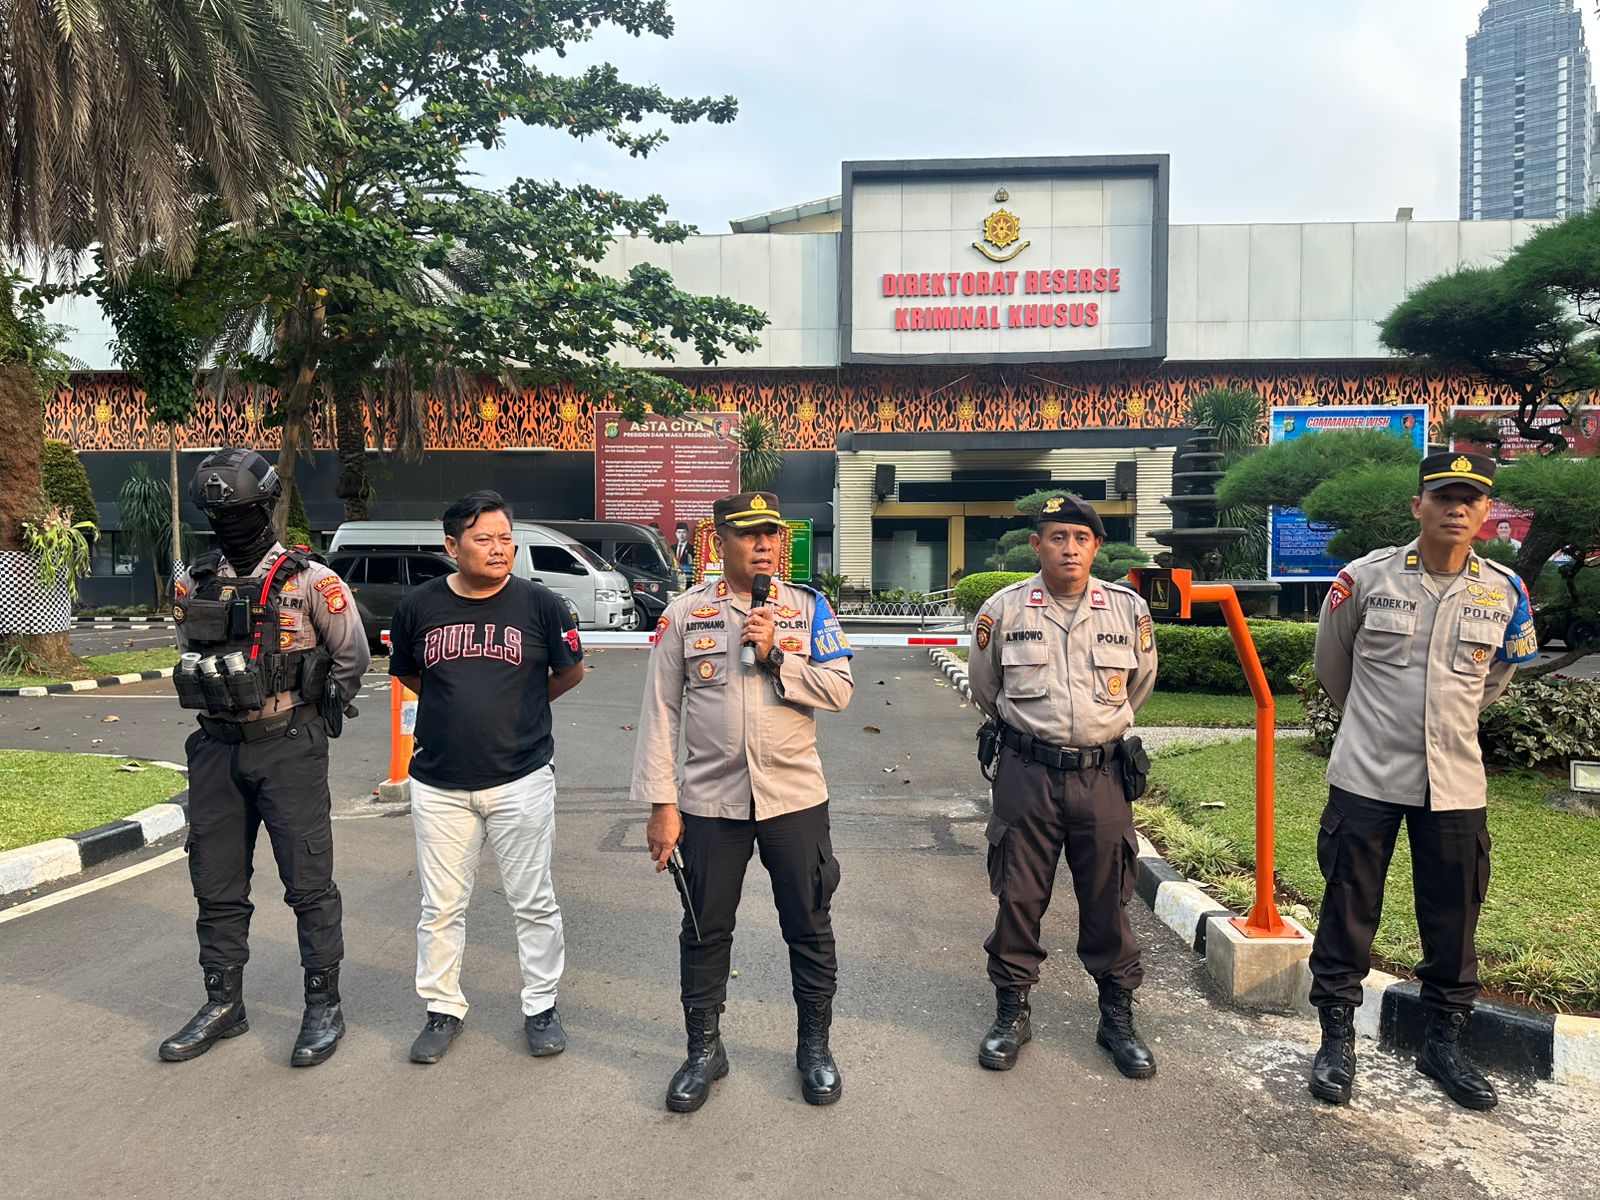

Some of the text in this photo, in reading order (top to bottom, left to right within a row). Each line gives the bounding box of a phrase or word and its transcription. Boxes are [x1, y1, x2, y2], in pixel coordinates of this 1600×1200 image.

[883, 268, 1120, 297] DIREKTORAT RESERSE
[895, 303, 1098, 331] KRIMINAL KHUSUS
[630, 421, 704, 431] ASTA CITA
[1307, 416, 1390, 428] COMMANDER WISH
[318, 576, 337, 589] POLDA
[1369, 597, 1401, 609] KADEK
[686, 620, 725, 632] ARITONANG
[1006, 630, 1043, 642] A.WIBOWO
[1097, 633, 1128, 645] POLRI
[424, 624, 522, 668] BULLS
